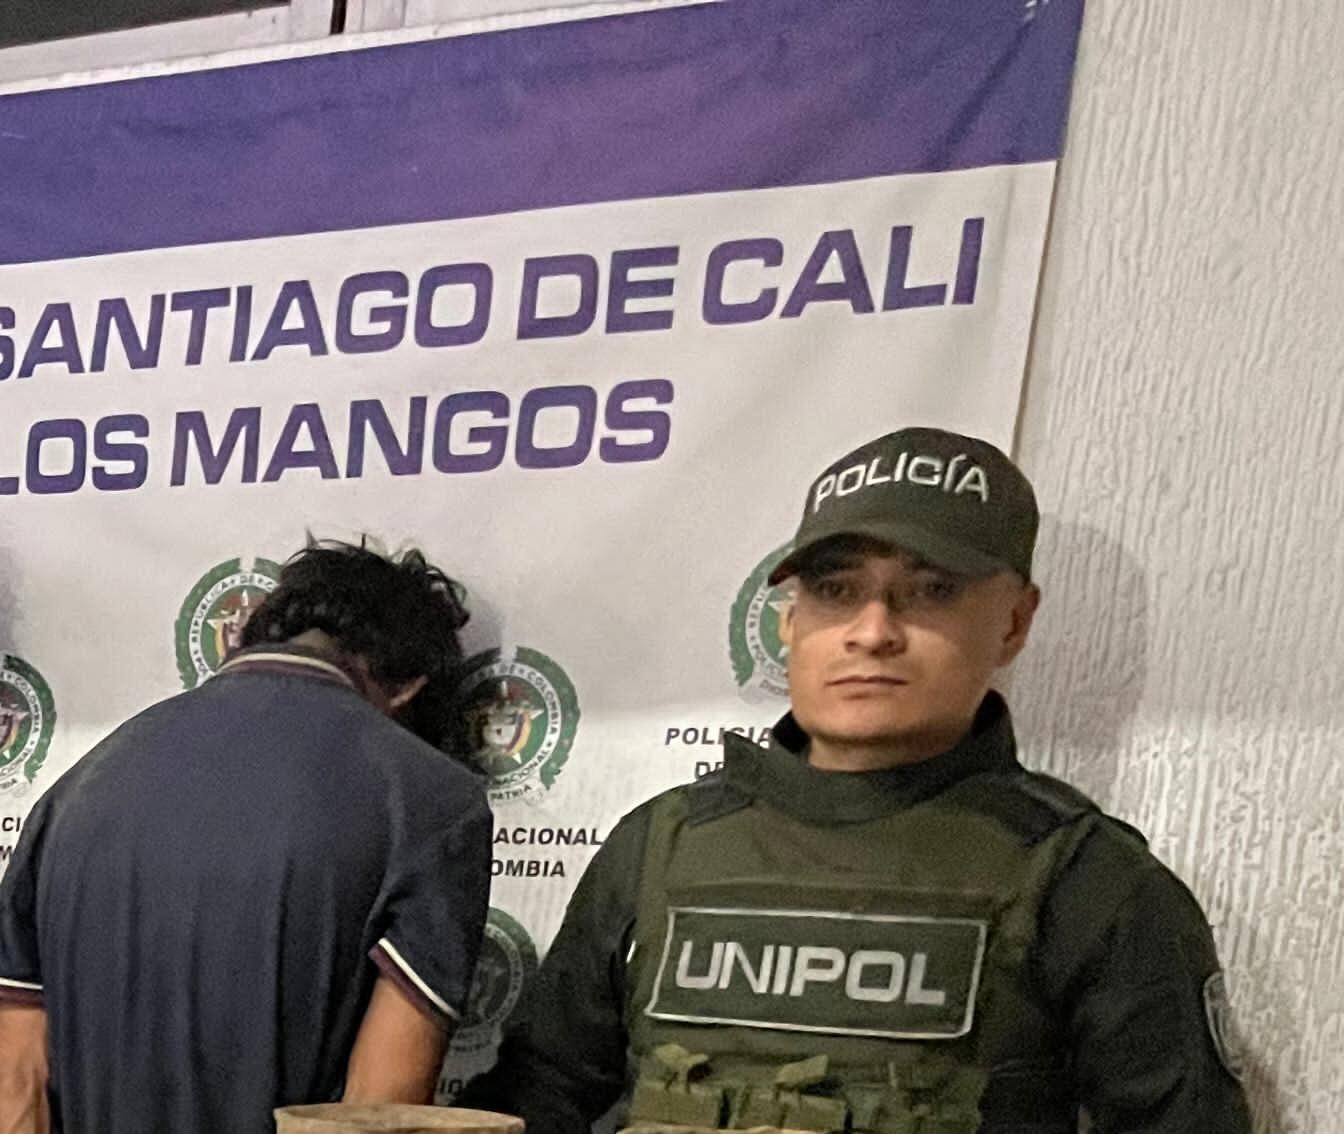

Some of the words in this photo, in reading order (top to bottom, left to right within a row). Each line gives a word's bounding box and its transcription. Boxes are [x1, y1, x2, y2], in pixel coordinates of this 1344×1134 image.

[518, 246, 681, 340] DE
[702, 216, 987, 326] CALI
[170, 378, 676, 488] MANGOS
[813, 451, 991, 513] POLICÍA
[674, 939, 947, 1005] UNIPOL
